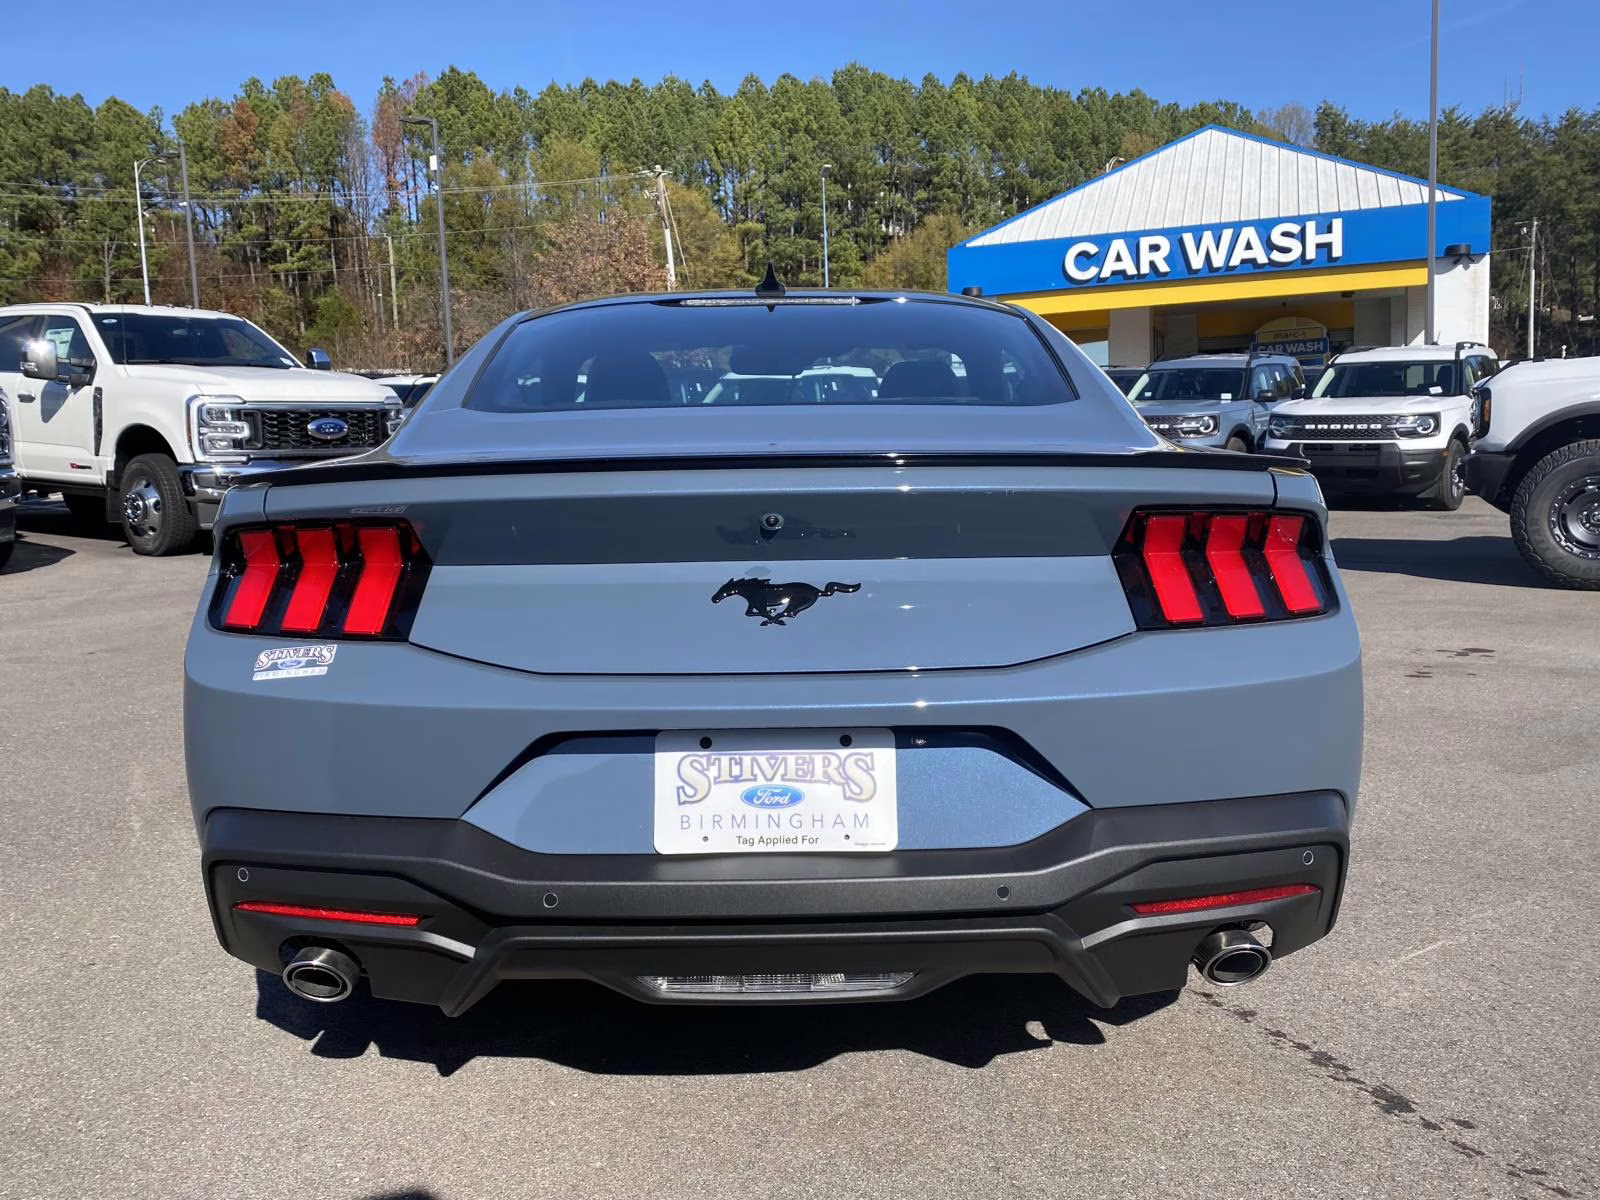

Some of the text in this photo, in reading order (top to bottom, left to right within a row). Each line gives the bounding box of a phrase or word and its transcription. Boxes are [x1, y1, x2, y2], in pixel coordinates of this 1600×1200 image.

[1063, 217, 1343, 282] CAR WASH
[1257, 341, 1324, 353] CAR WASH
[254, 645, 335, 670] STIVERS
[677, 751, 877, 806] STIVERS
[753, 788, 793, 805] Ford
[680, 813, 870, 830] BIRMINGHAM
[736, 834, 820, 847] Tag Applied For
